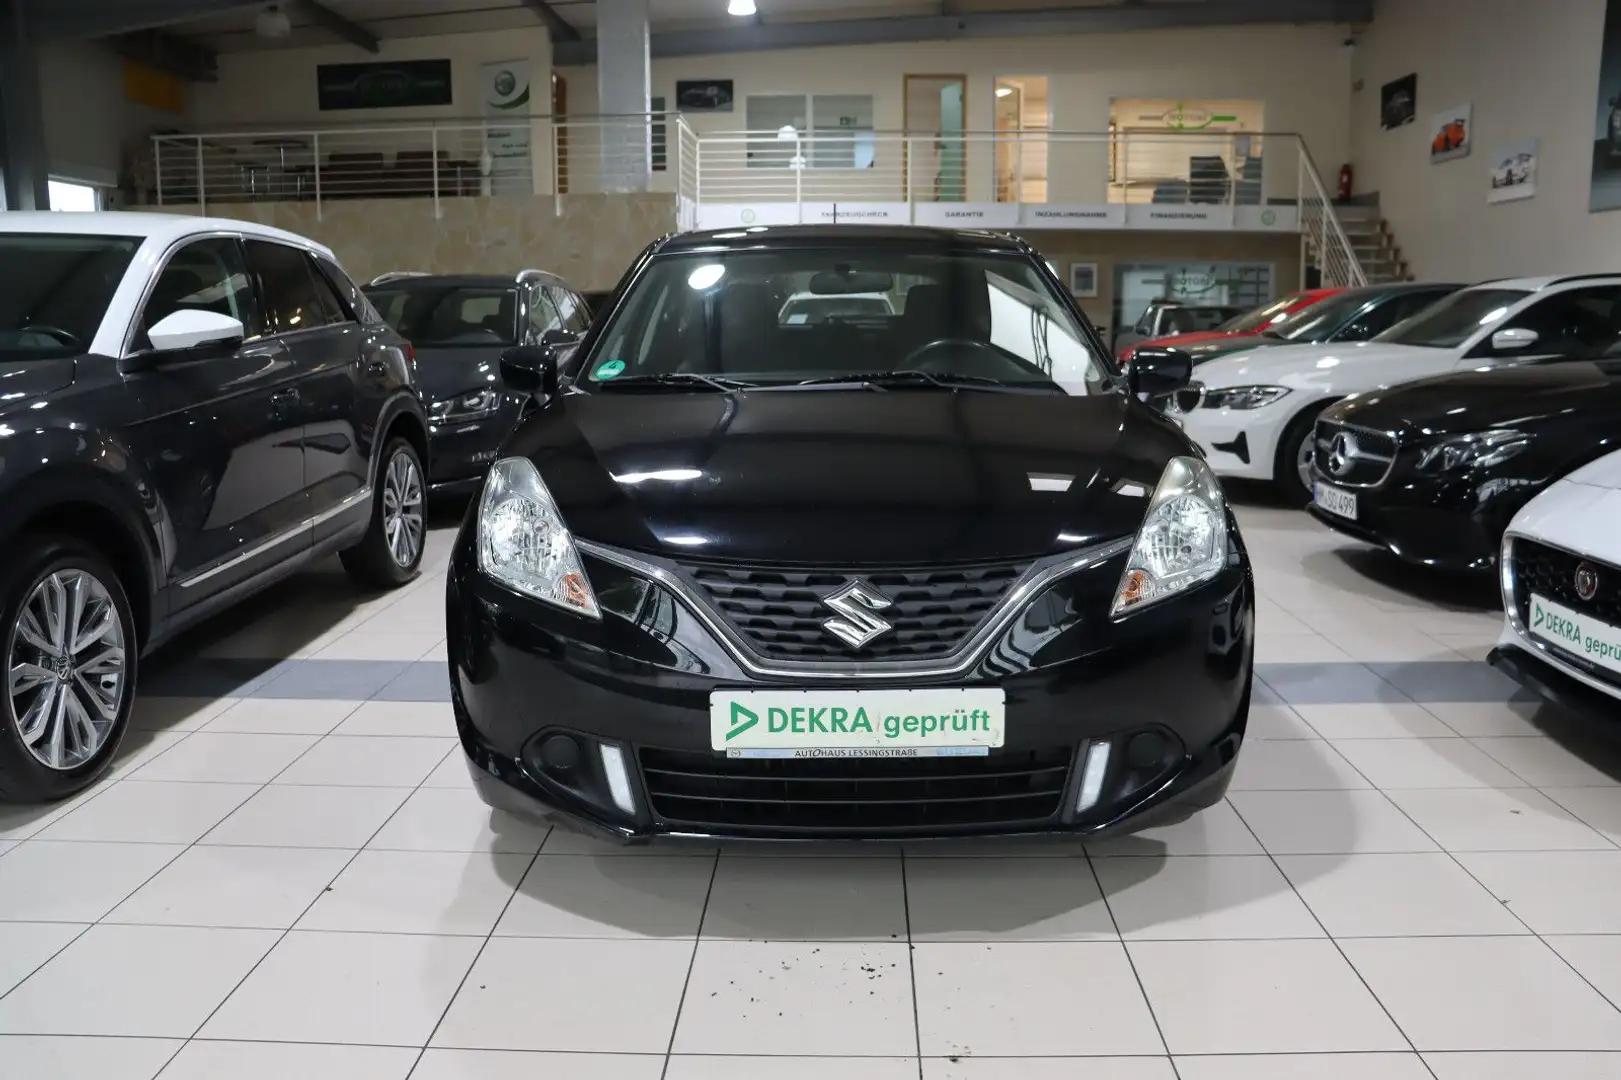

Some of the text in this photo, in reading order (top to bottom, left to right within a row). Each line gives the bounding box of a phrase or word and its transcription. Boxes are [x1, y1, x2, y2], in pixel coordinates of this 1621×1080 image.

[608, 361, 617, 369] 4
[1339, 494, 1355, 516] 499
[1546, 612, 1582, 644] DEKRA
[768, 707, 990, 738] DEKRA geprüft
[794, 748, 846, 757] AUTOHAUS
